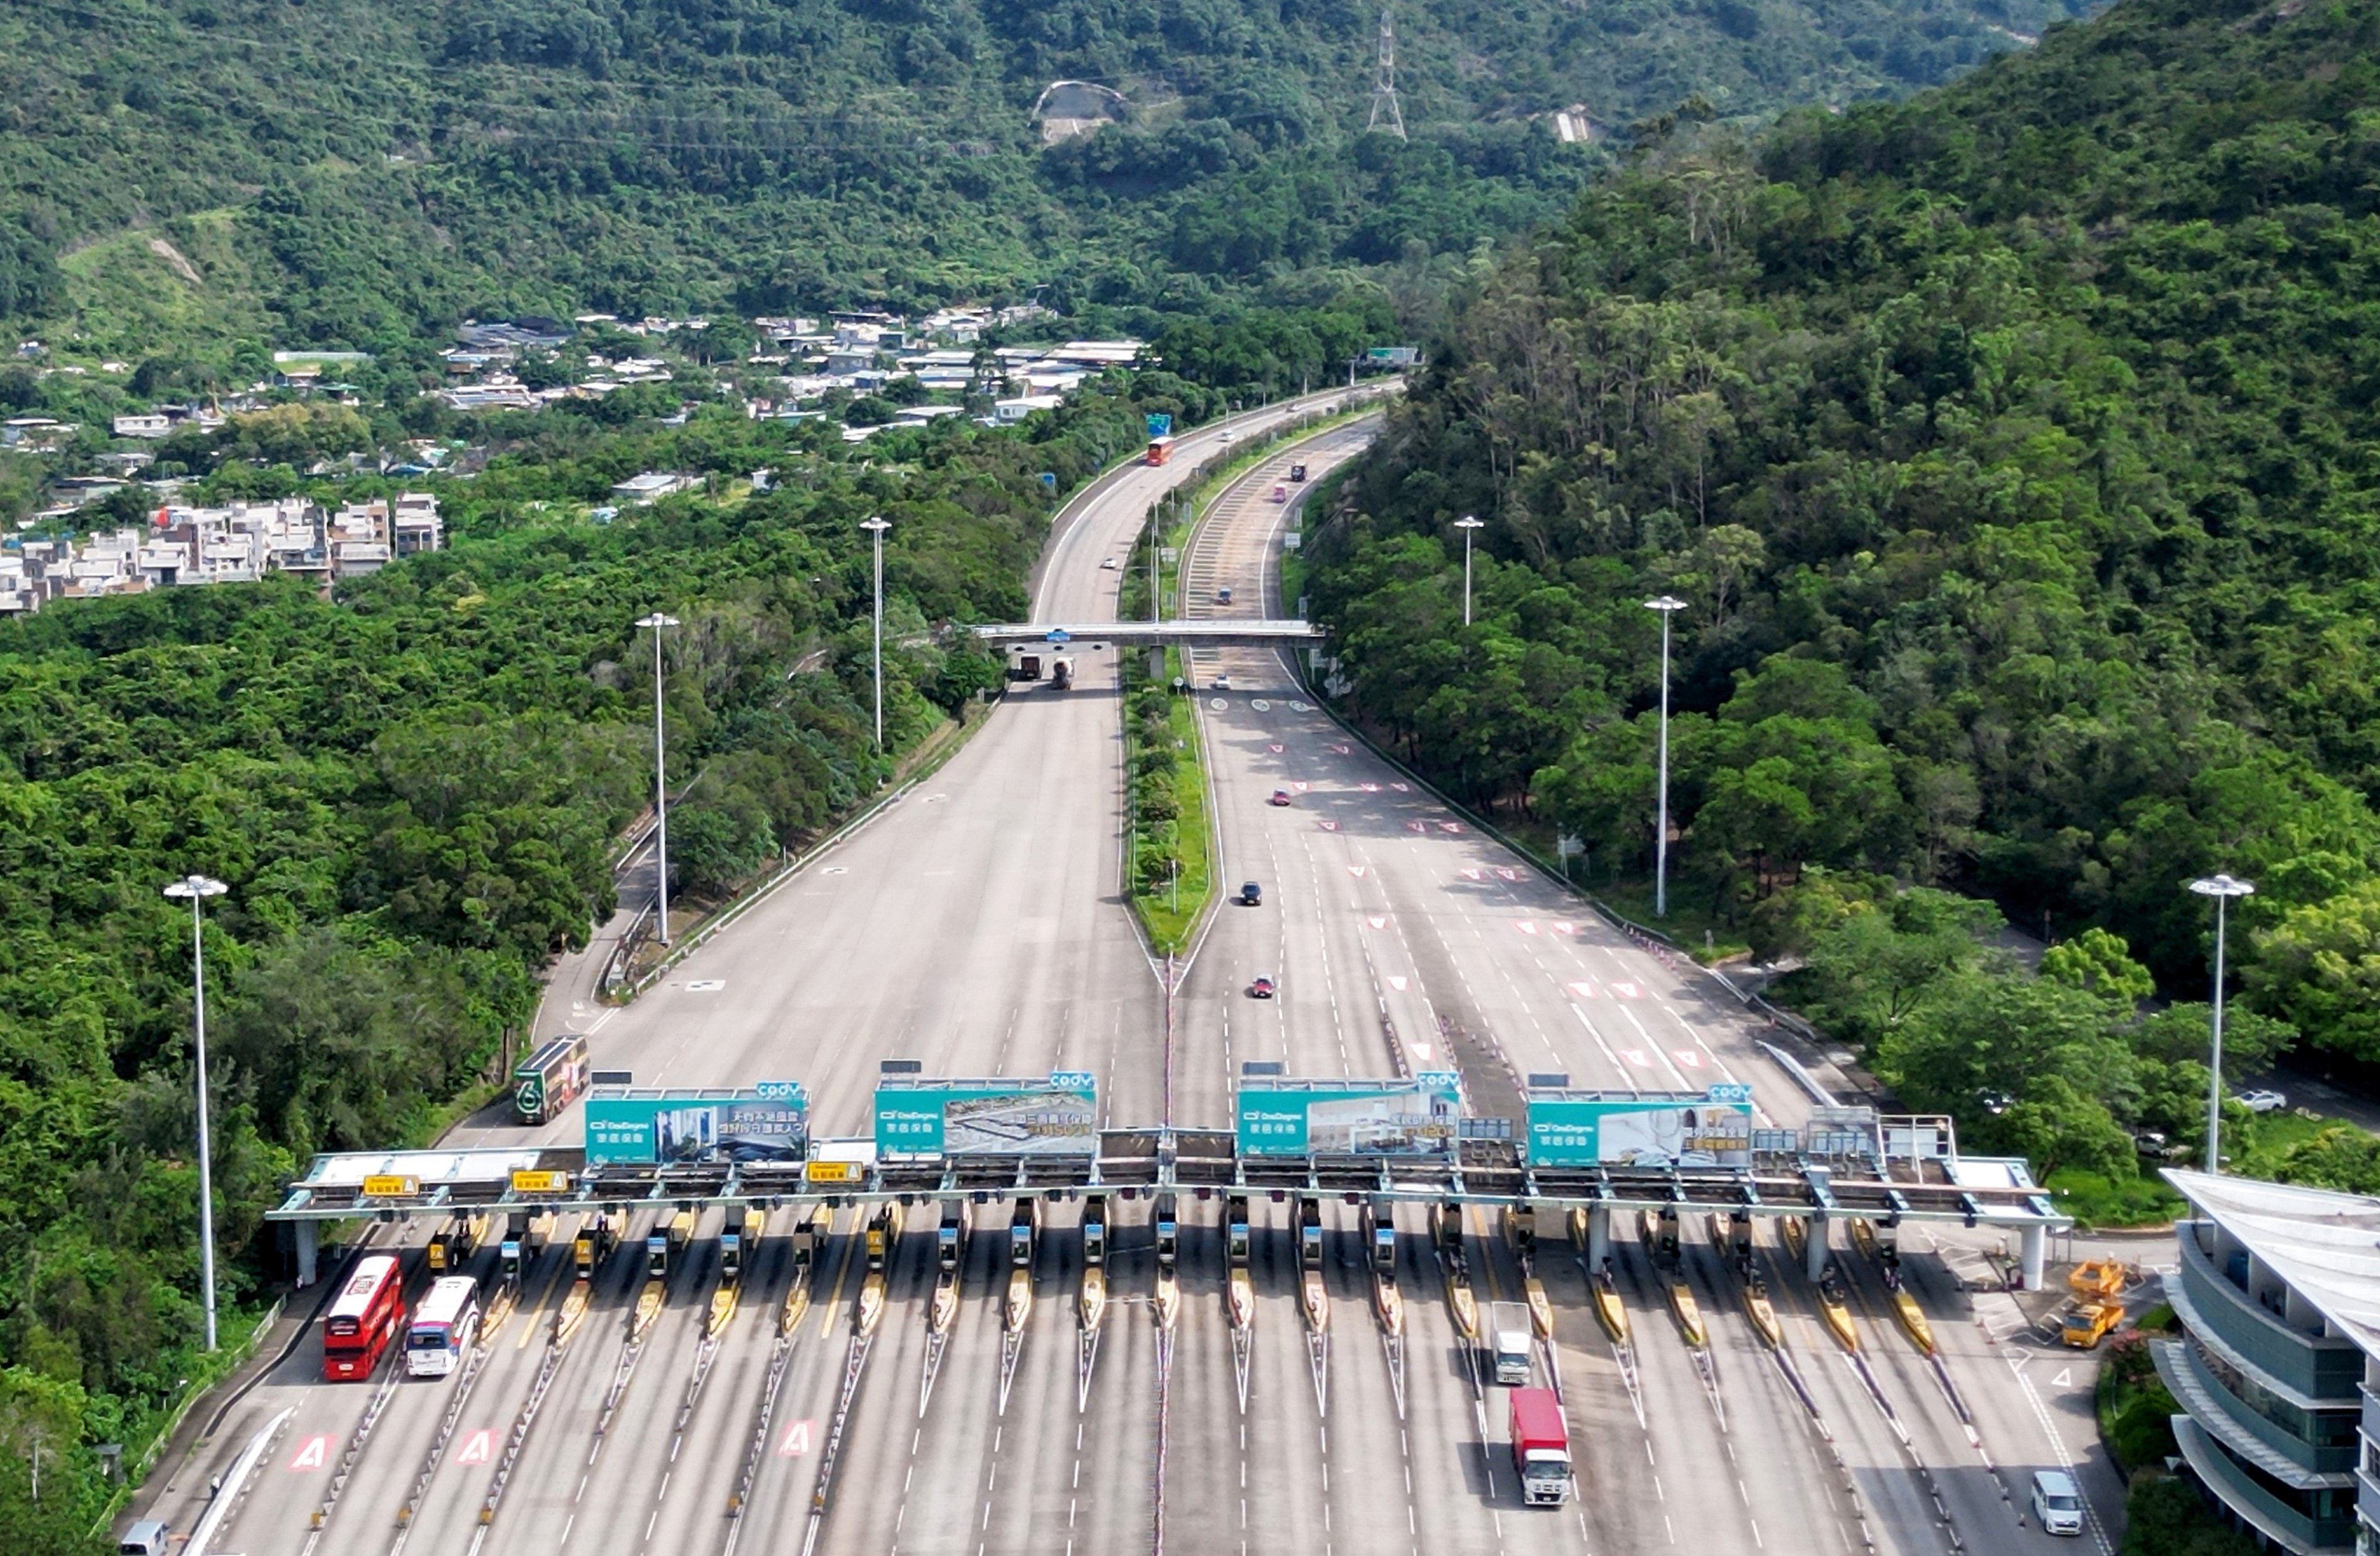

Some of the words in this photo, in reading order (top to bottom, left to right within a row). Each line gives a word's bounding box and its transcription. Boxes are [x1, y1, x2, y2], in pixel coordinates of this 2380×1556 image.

[758, 1084, 799, 1096] cody
[1050, 1075, 1091, 1086] cody
[292, 1437, 325, 1468] A
[458, 1432, 489, 1462] A
[780, 1423, 808, 1454] A
